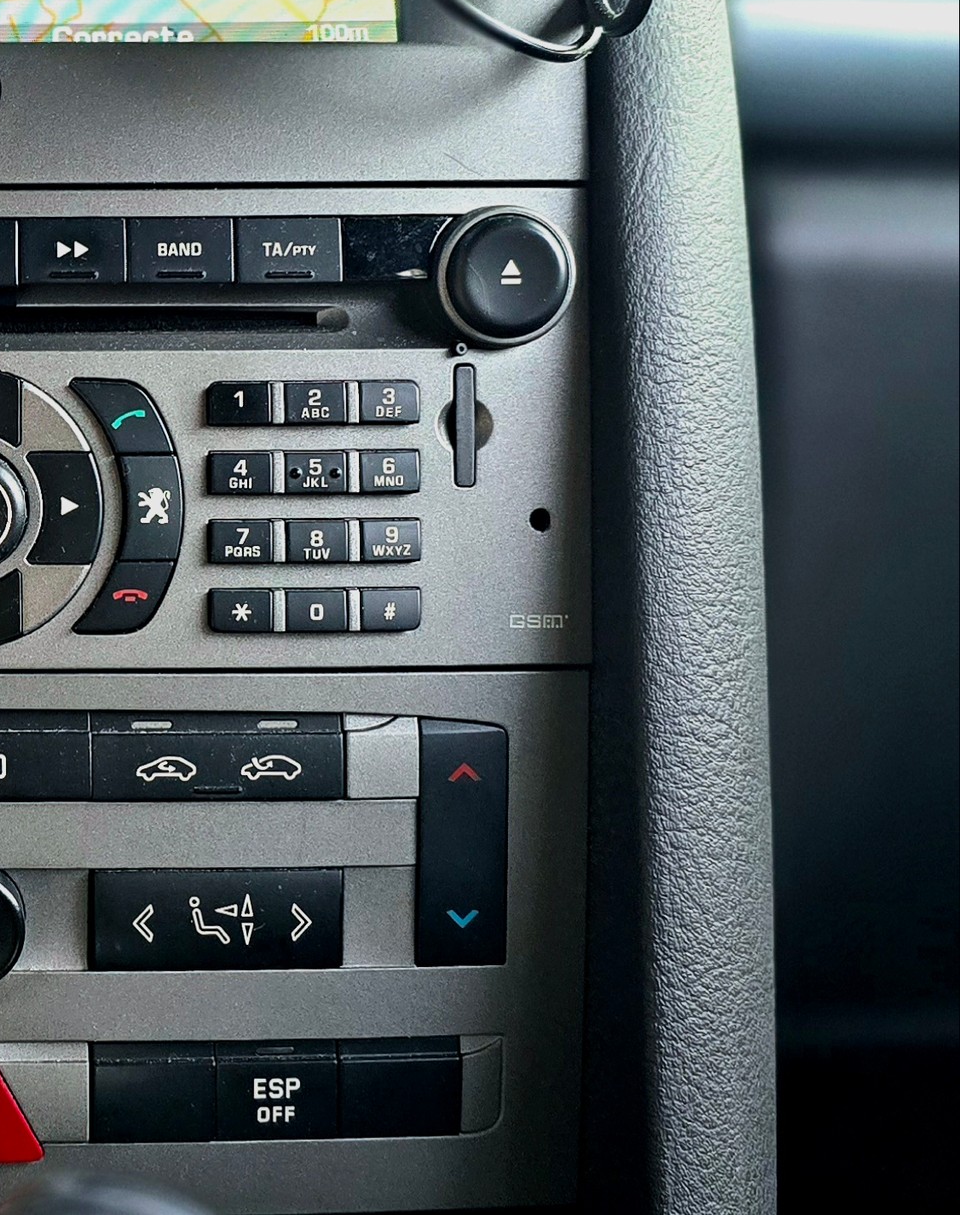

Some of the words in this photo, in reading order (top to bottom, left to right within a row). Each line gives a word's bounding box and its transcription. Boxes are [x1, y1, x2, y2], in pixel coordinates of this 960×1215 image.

[157, 241, 202, 257] BAND
[262, 241, 317, 257] TA/PTY
[233, 390, 245, 408] 1
[308, 388, 322, 406] 2
[381, 387, 396, 405] 3
[300, 406, 330, 419] ABC
[374, 405, 403, 418] DEF
[233, 459, 248, 476] 4
[308, 458, 323, 475] 5
[382, 457, 396, 474] 6
[228, 476, 253, 490] GHI
[302, 475, 329, 488] JKL
[373, 474, 404, 487] MNO
[236, 527, 250, 545] 7
[310, 529, 324, 547] 8
[385, 526, 399, 544] 9
[224, 545, 261, 558] PQRS
[302, 547, 331, 560] TUV
[372, 544, 411, 557] WXYZ
[309, 603, 324, 622] 0
[253, 1077, 301, 1100] ESP
[256, 1104, 296, 1124] OFF
